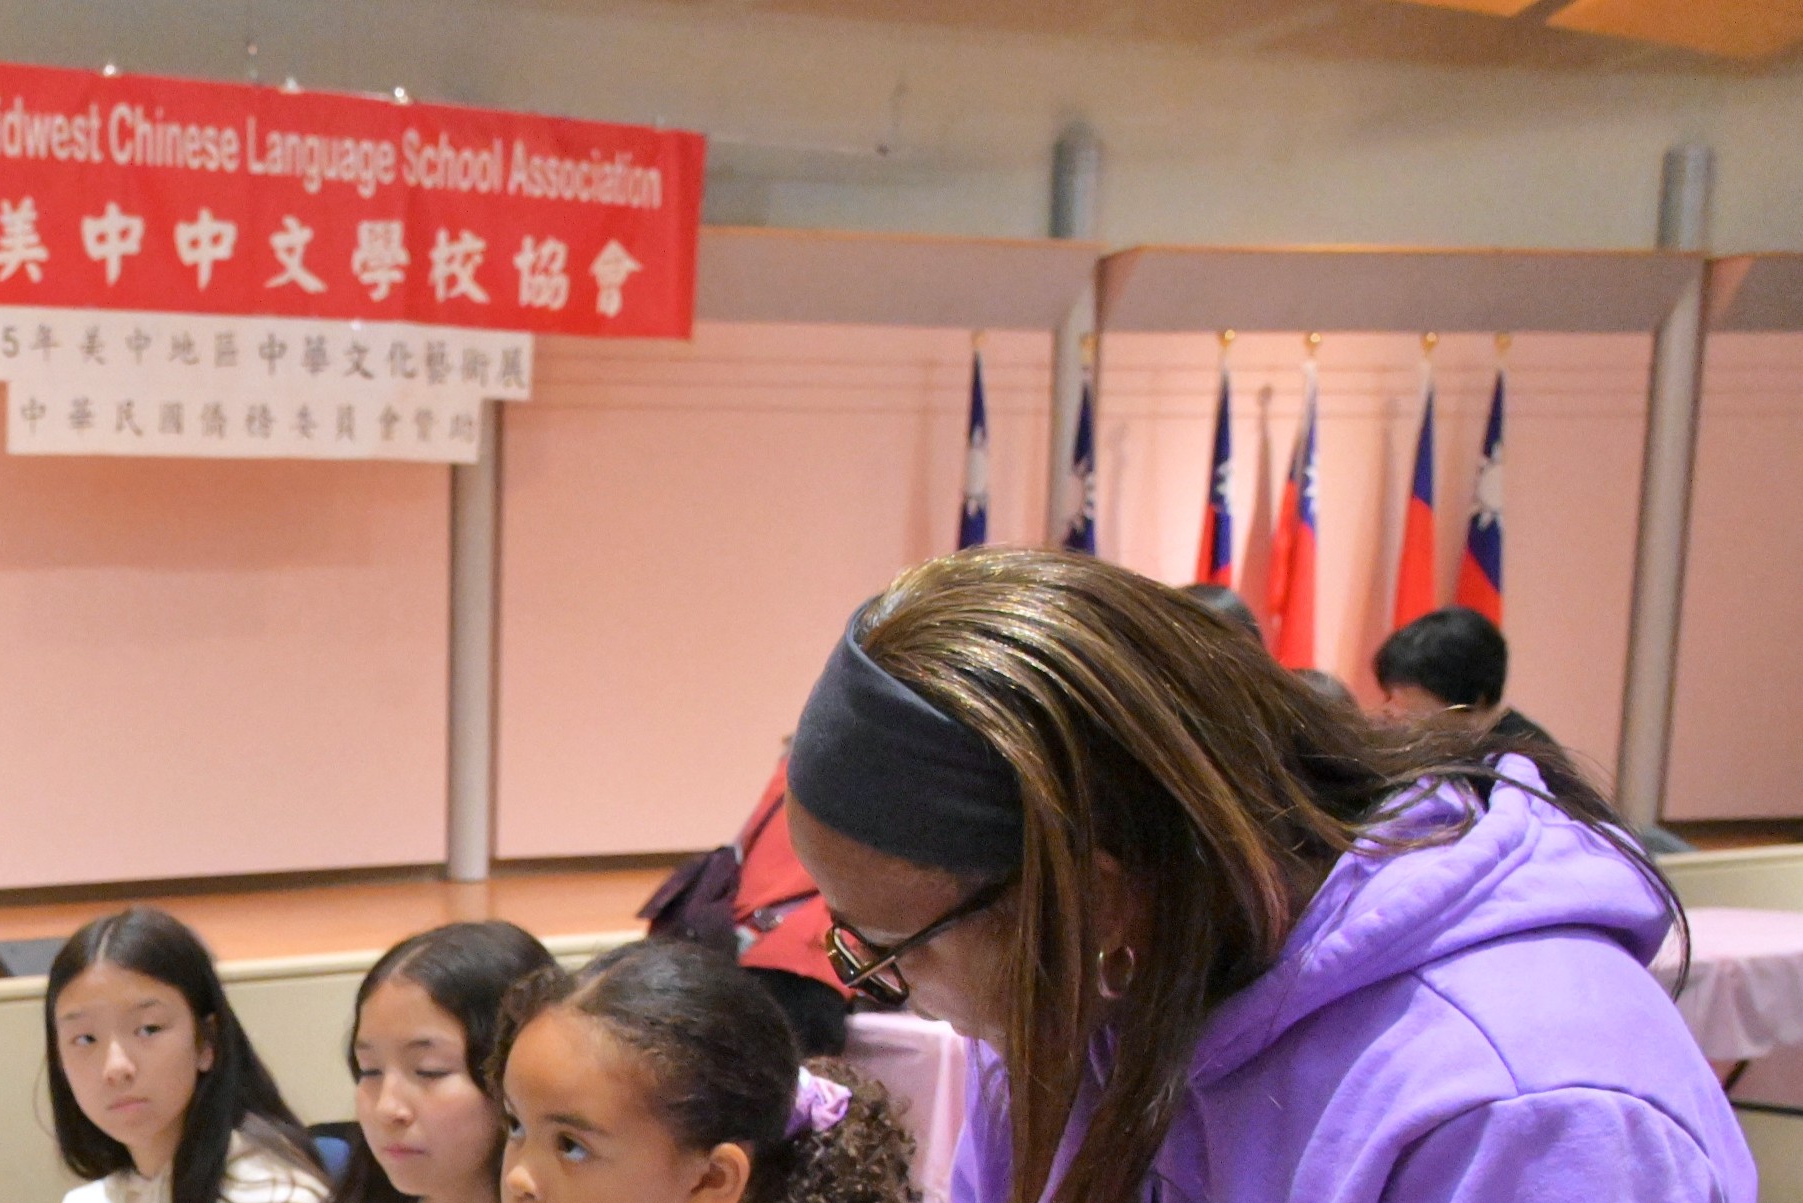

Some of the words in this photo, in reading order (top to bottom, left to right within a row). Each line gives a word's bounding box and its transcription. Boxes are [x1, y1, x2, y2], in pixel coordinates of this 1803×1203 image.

[108, 102, 240, 173] Chinese
[247, 115, 395, 198] Language
[402, 128, 504, 194] School
[508, 139, 662, 209] Association
